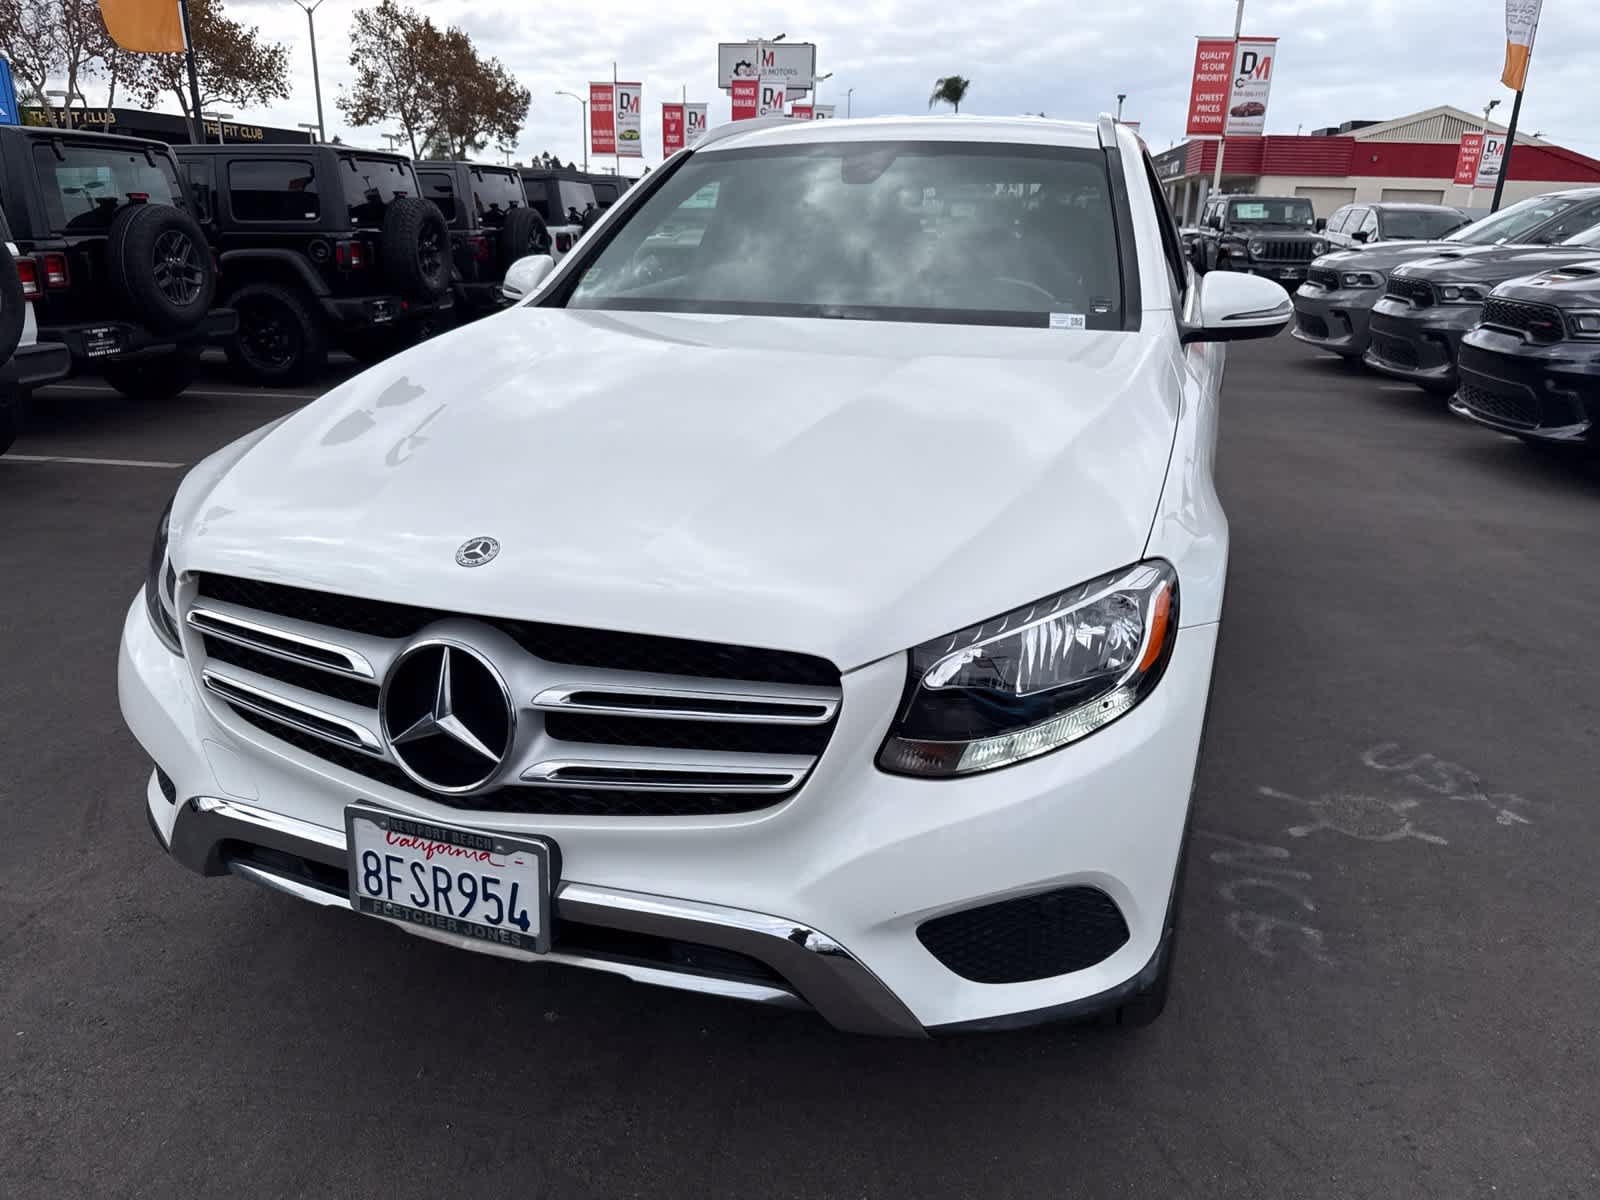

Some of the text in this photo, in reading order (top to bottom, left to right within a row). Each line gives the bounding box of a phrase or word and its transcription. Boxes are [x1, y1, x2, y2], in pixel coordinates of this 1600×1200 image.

[1200, 51, 1230, 60] QUALITY
[1202, 63, 1225, 71] IS OUR
[1240, 52, 1272, 80] DM
[1196, 74, 1228, 82] PRIORITY
[620, 93, 639, 113] DM
[1196, 93, 1224, 102] LOWEST
[1196, 104, 1220, 113] PRICES
[1192, 115, 1222, 123] IN TOWN
[224, 125, 240, 137] FIT
[240, 126, 263, 140] CLUB
[388, 816, 493, 851] NEWPORT BEACH
[386, 831, 505, 867] California
[362, 850, 531, 932] 8FSR954
[373, 900, 521, 946] FLETCHER JONES
